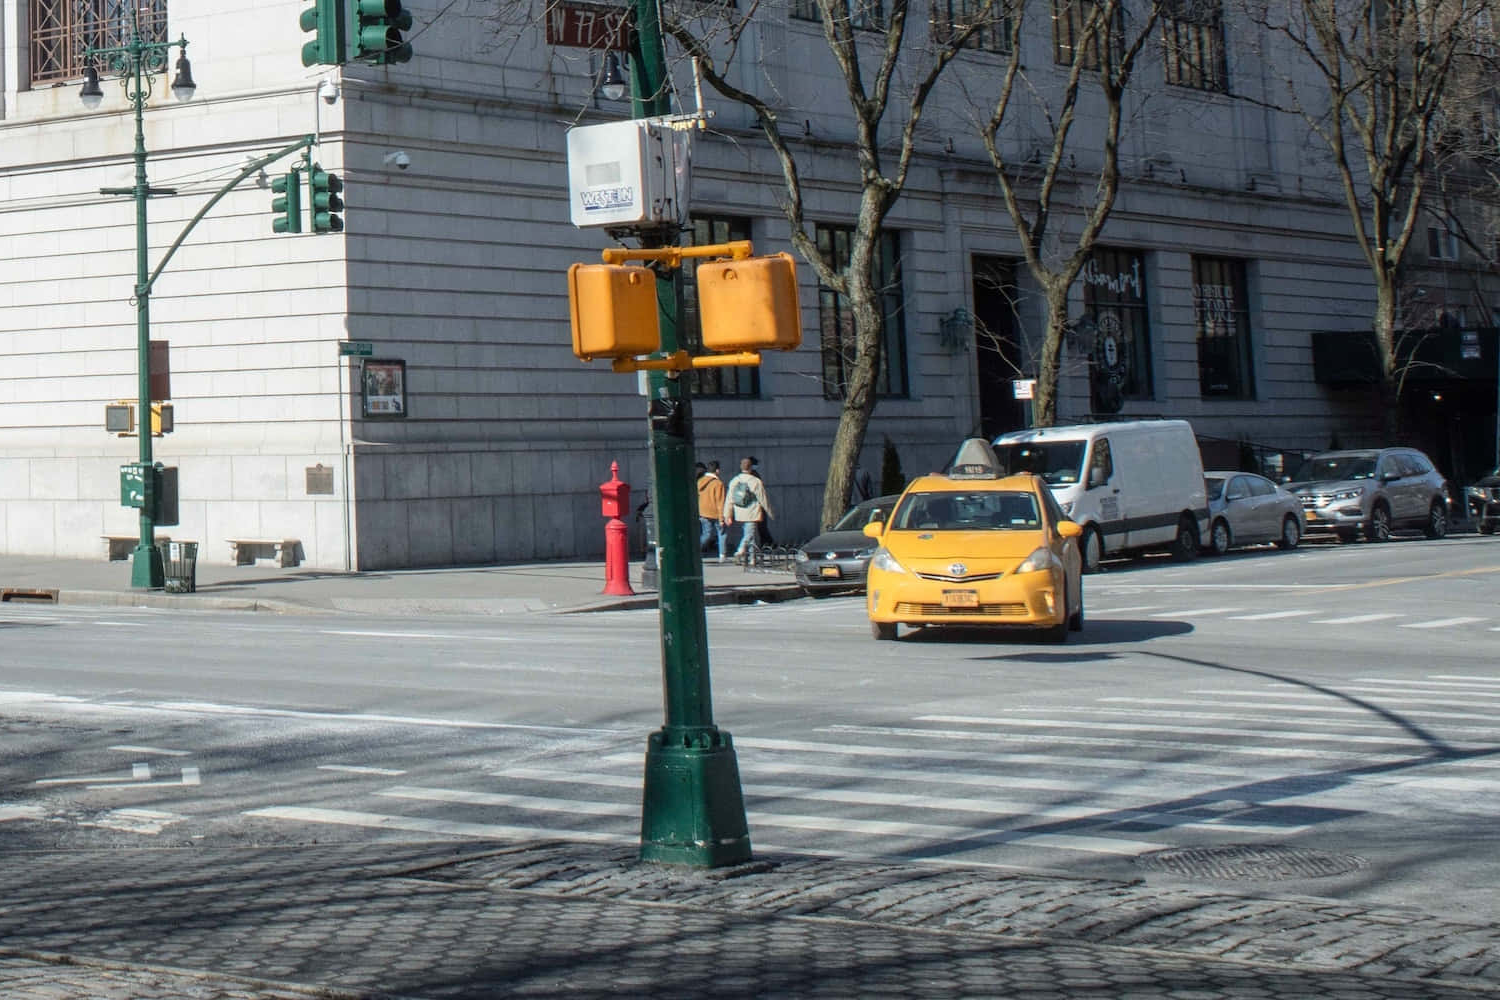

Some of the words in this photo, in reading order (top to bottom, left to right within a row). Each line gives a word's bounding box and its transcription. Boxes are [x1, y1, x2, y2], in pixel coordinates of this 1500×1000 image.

[551, 7, 566, 42] W
[575, 10, 596, 45] 77
[604, 12, 622, 48] ST
